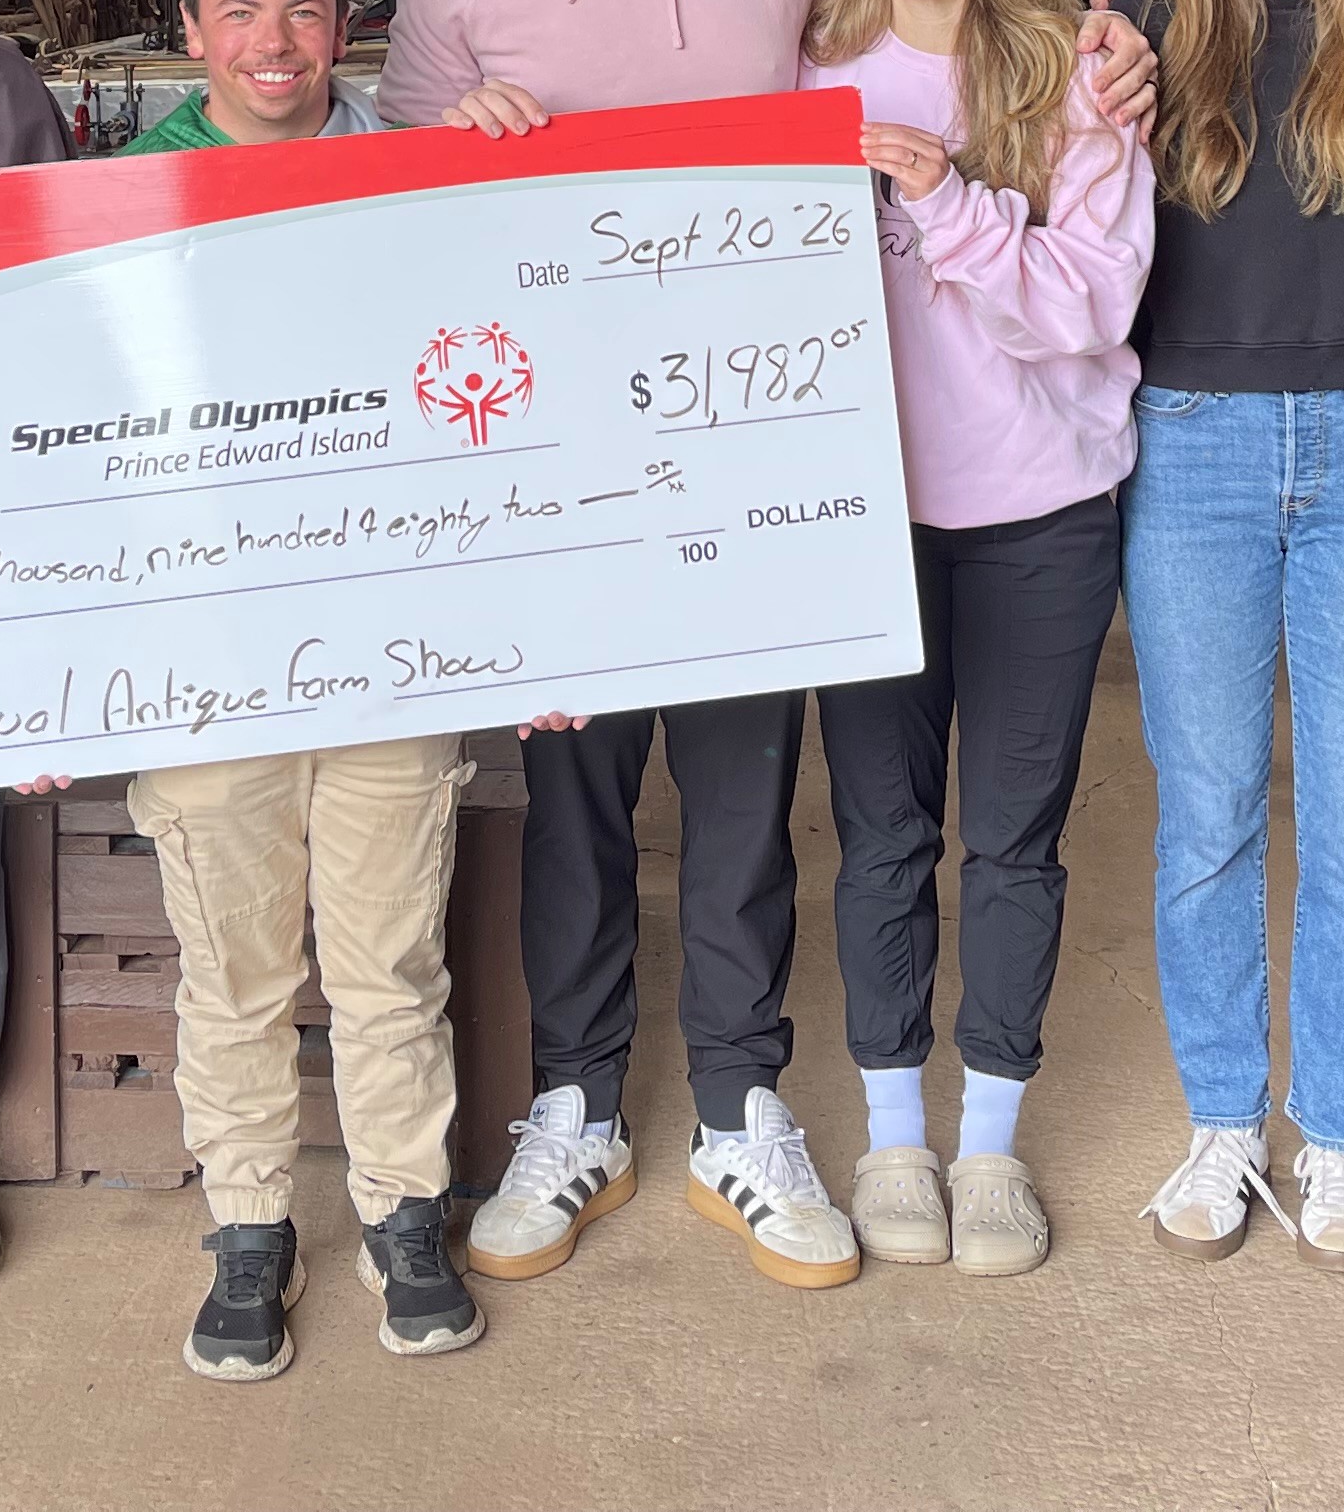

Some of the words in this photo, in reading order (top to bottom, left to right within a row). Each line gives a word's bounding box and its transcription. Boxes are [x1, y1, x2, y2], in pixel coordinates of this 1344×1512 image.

[517, 262, 570, 289] Date
[590, 210, 702, 288] Sept
[717, 207, 774, 255] 20
[10, 406, 172, 456] Special
[188, 386, 389, 432] Olympics
[103, 452, 190, 481] Prince
[197, 437, 302, 471] Edward
[310, 421, 392, 457] Island
[146, 538, 229, 575] nine
[236, 506, 349, 556] hundred
[386, 498, 492, 559] eighty
[502, 483, 563, 524] two
[746, 495, 868, 530] DOLLARS
[677, 540, 719, 564] 100
[102, 667, 270, 736] Antique
[383, 637, 524, 689] Show
